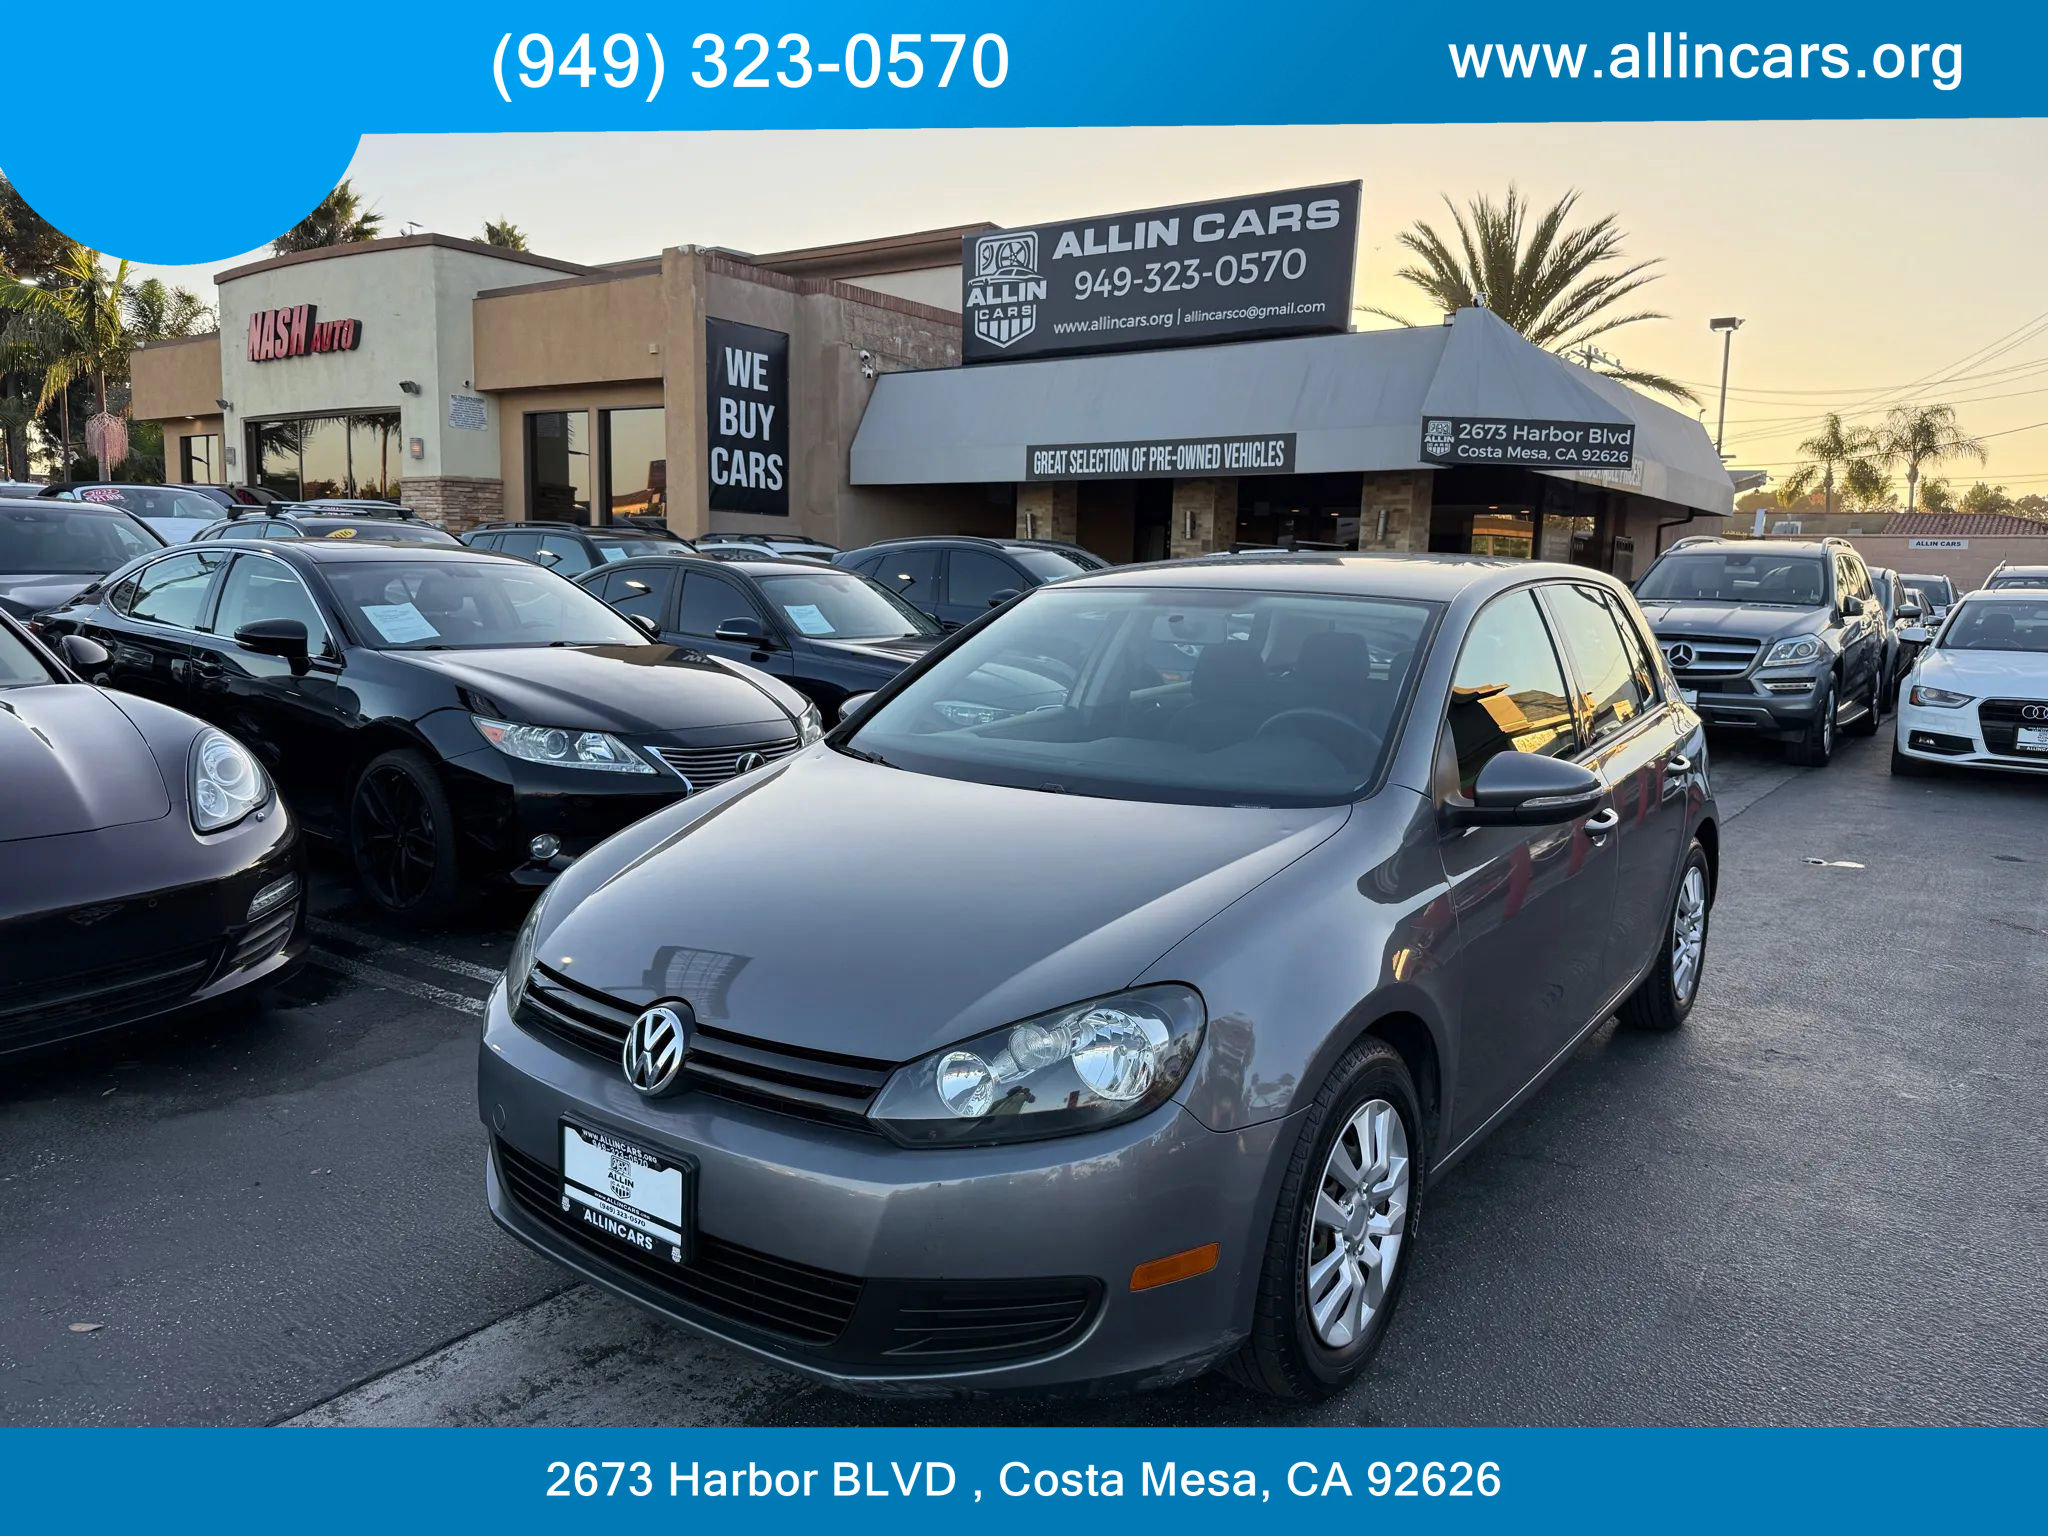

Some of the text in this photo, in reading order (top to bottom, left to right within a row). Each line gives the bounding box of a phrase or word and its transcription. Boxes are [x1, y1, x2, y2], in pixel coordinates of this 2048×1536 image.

[1053, 199, 1340, 260] ALLIN CARS
[1074, 248, 1306, 301] 949-323-0570
[966, 280, 1047, 307] ALLIN
[979, 305, 1032, 320] CARS
[1053, 302, 1326, 334] www.allincars.org allincarsco@gmail.com
[248, 304, 355, 361] NASH AUTO
[725, 347, 769, 392] WE
[720, 397, 775, 441] BUY
[1459, 423, 1631, 446] 2673 Harbor Blvd
[1424, 435, 1454, 444] ALLIN
[1457, 445, 1629, 463] Costa Mesa, CA 92626
[711, 446, 783, 491] CARS
[1033, 440, 1285, 475] GREAT SELECTION OF PRE-OWNED VEHICLES
[608, 1172, 634, 1188] ALLIN
[584, 1209, 653, 1250] ALLINCARS
